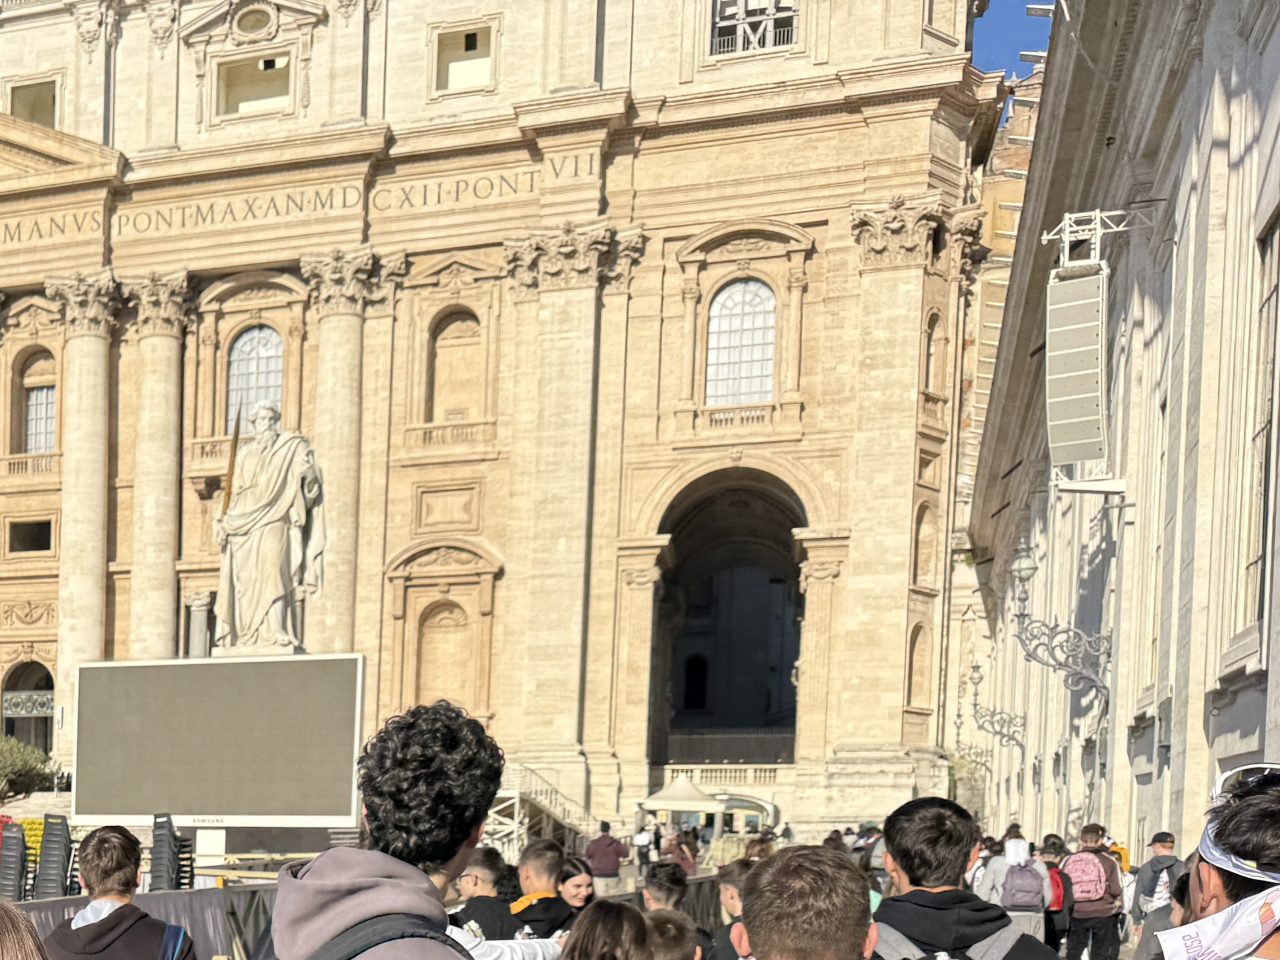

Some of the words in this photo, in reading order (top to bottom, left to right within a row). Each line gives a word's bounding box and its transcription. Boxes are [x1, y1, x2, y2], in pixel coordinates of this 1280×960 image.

[117, 205, 193, 236] PONT
[193, 197, 257, 227] MAX
[455, 170, 541, 202] PONT
[549, 153, 595, 180] VII
